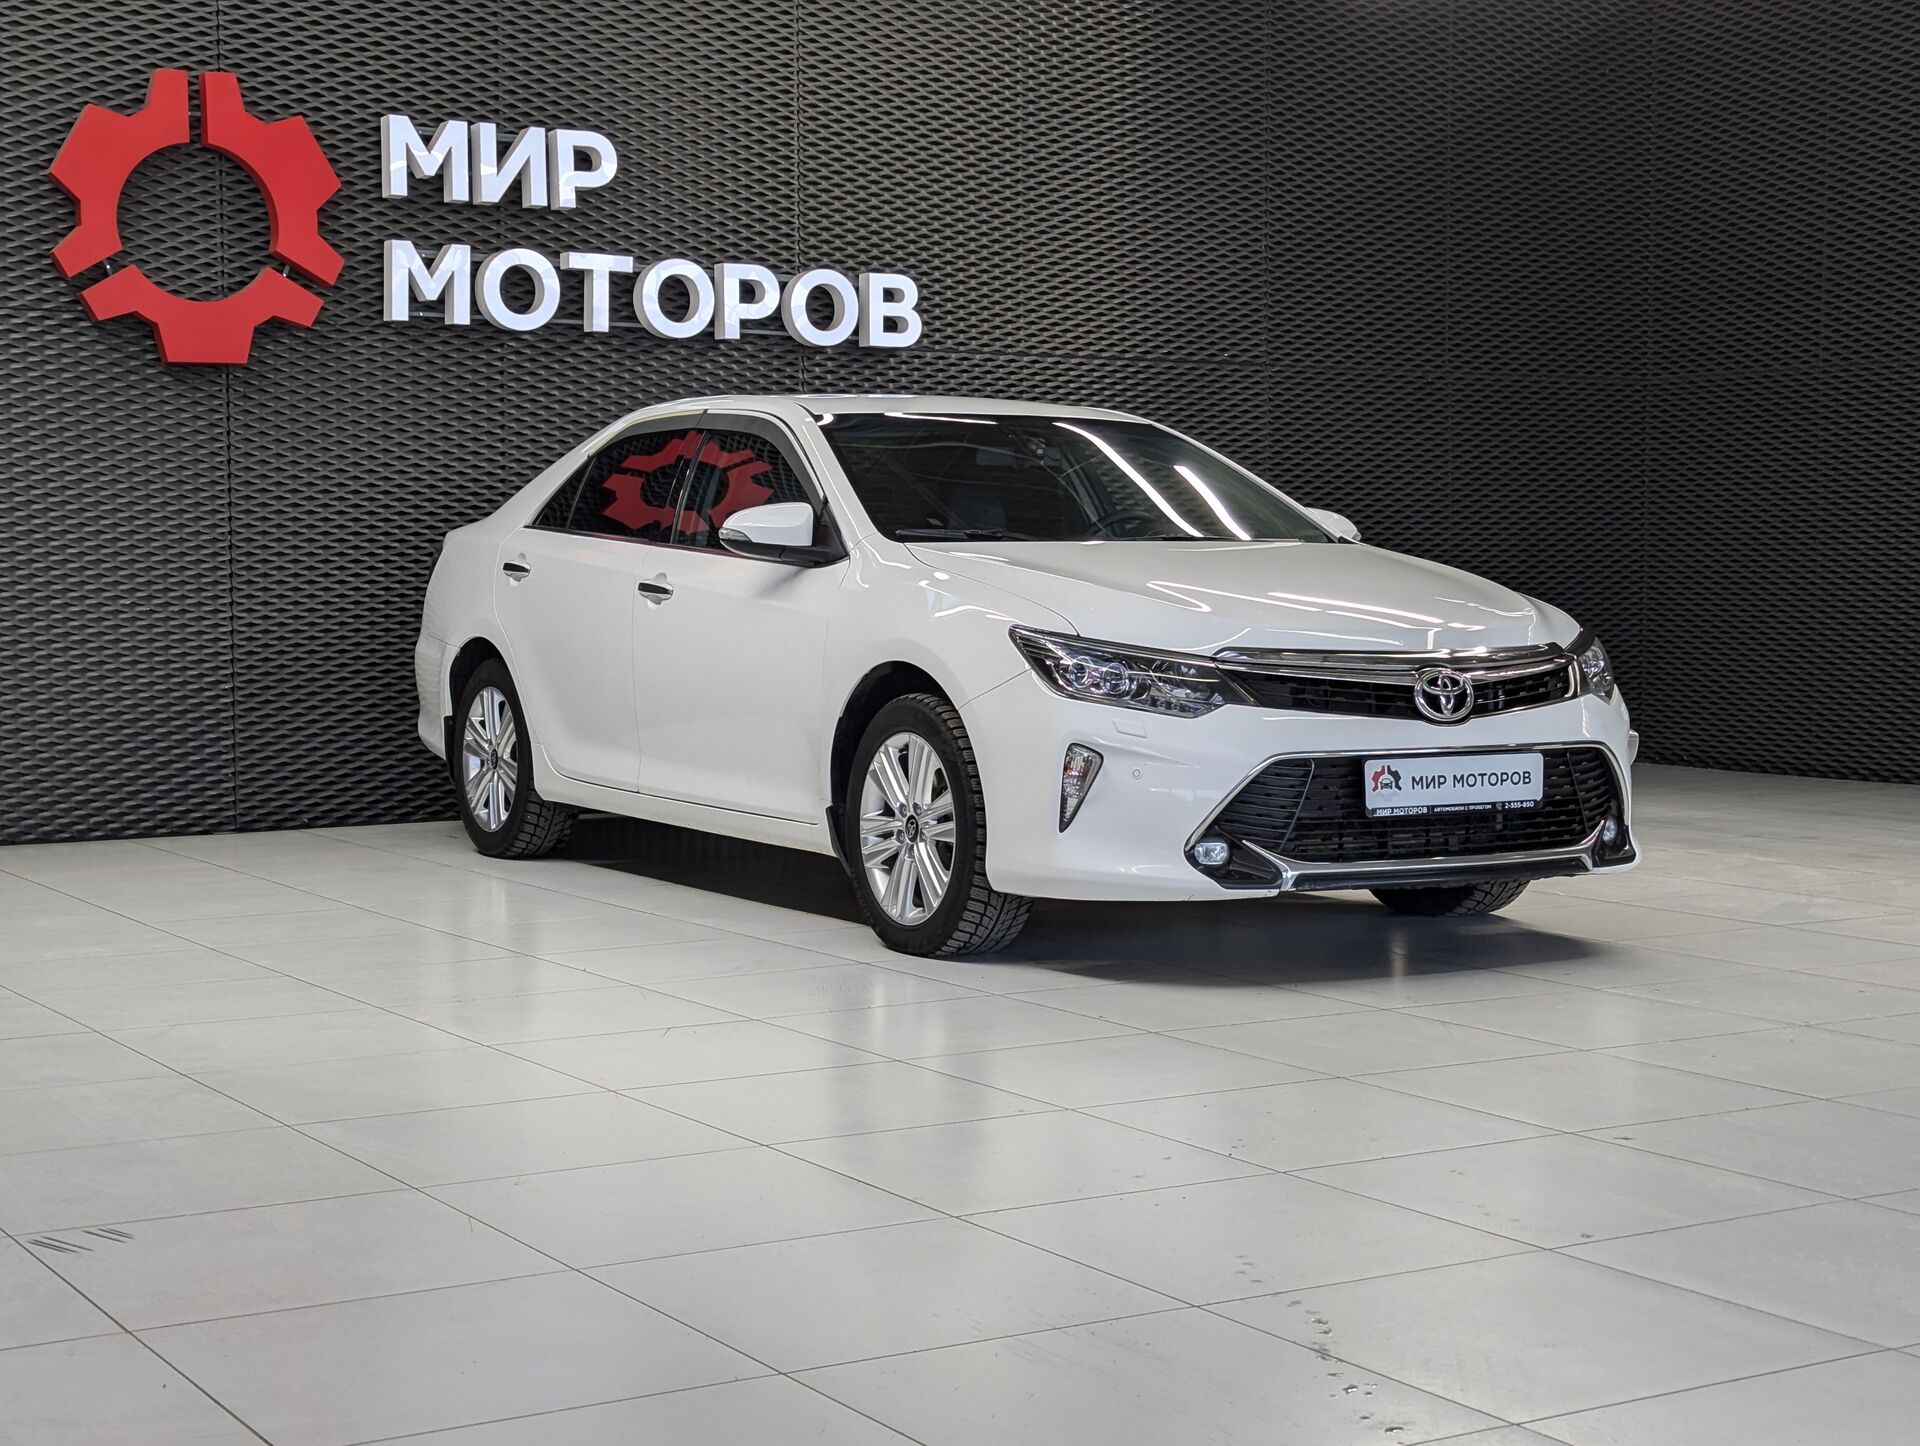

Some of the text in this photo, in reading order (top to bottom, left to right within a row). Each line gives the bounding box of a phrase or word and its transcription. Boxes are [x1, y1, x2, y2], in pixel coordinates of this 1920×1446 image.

[380, 114, 618, 210] МИР
[382, 239, 923, 348] МОТОРОВ
[1411, 771, 1532, 790] МИР МОТОРОВ
[1393, 806, 1428, 815] МОТОРОВ
